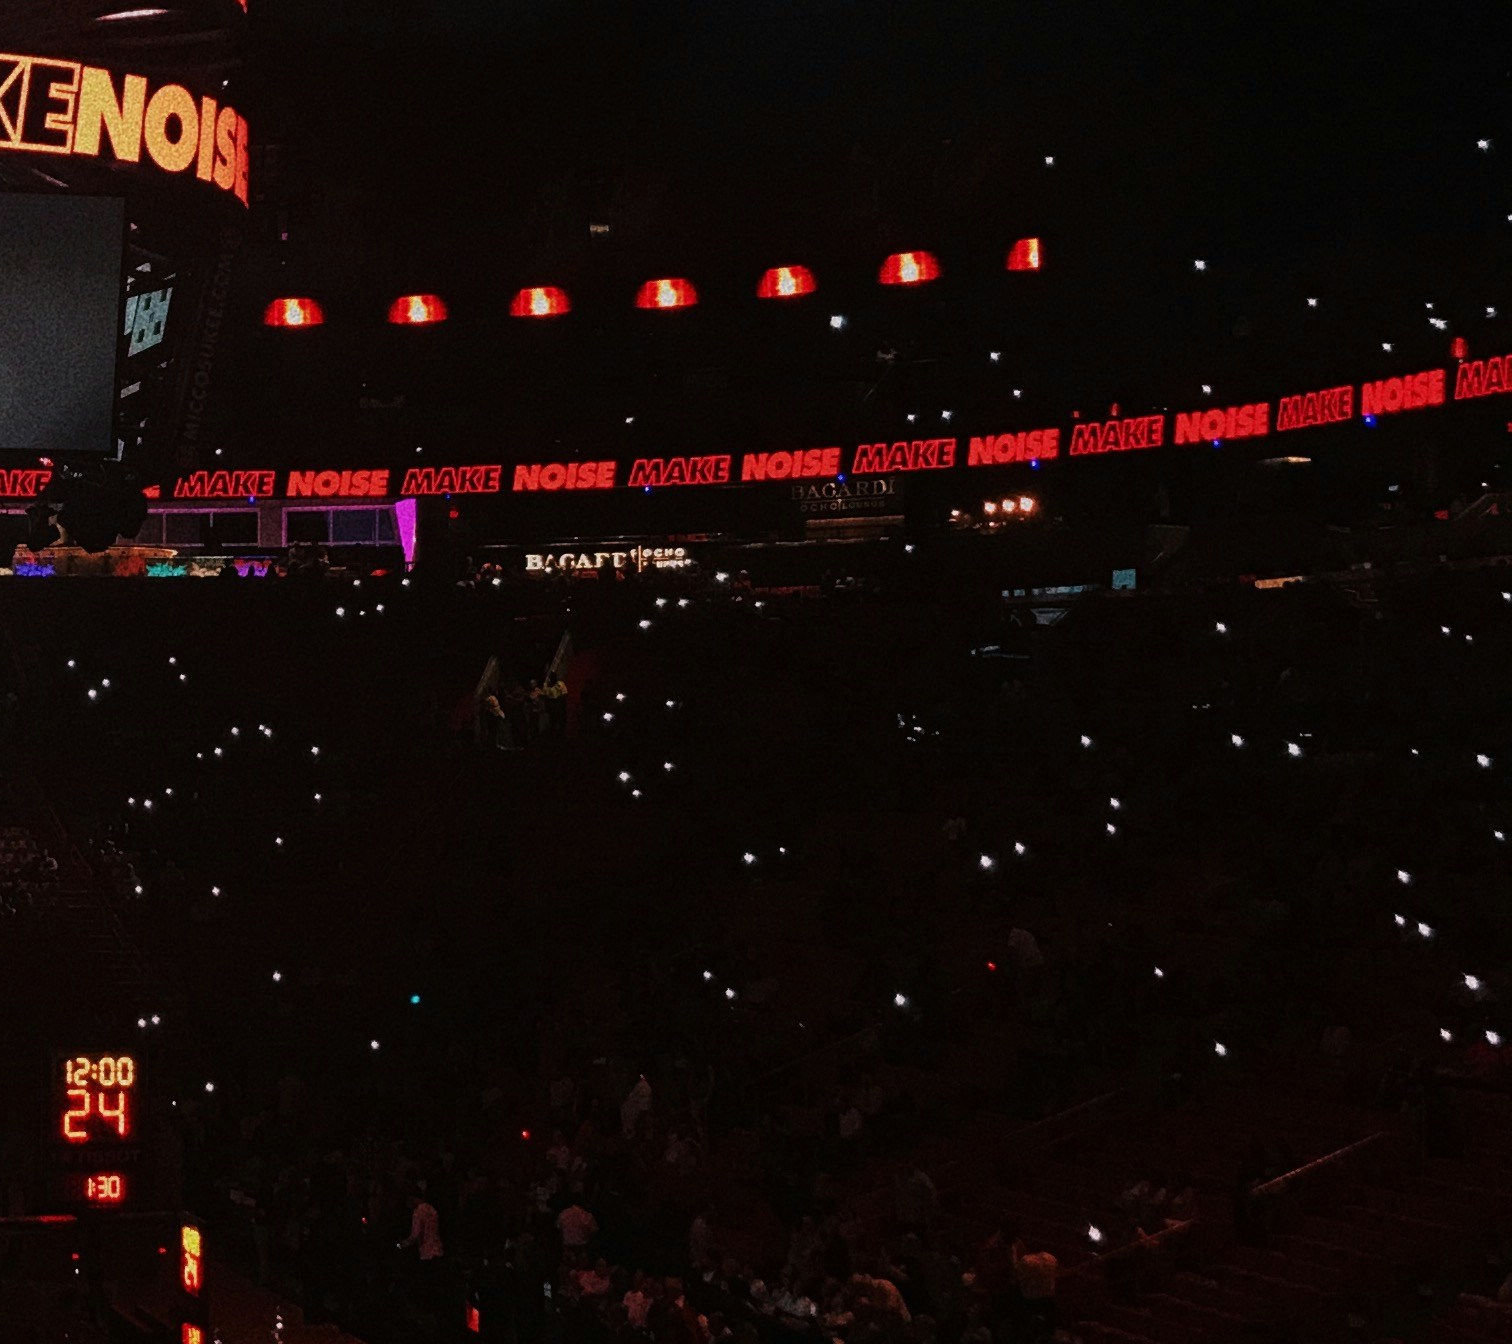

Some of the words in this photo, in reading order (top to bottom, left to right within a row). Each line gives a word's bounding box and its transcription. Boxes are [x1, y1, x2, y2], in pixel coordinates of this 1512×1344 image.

[174, 470, 275, 497] MAKE
[286, 469, 390, 497] NOISE
[402, 465, 502, 495] MAKE
[513, 461, 617, 491] NOISE
[628, 455, 731, 487] MAKE
[742, 447, 841, 481] NOISE
[852, 438, 956, 474] MAKE
[968, 428, 1060, 466] NOISE
[1070, 415, 1164, 455] MAKE
[1174, 403, 1270, 445] NOISE
[1277, 385, 1353, 431] MAKE
[1361, 369, 1446, 416] NOISE
[791, 477, 896, 500] BACARDI
[65, 1056, 135, 1087] 12:00
[63, 1088, 126, 1139] 24
[87, 1175, 122, 1199] 1:30
